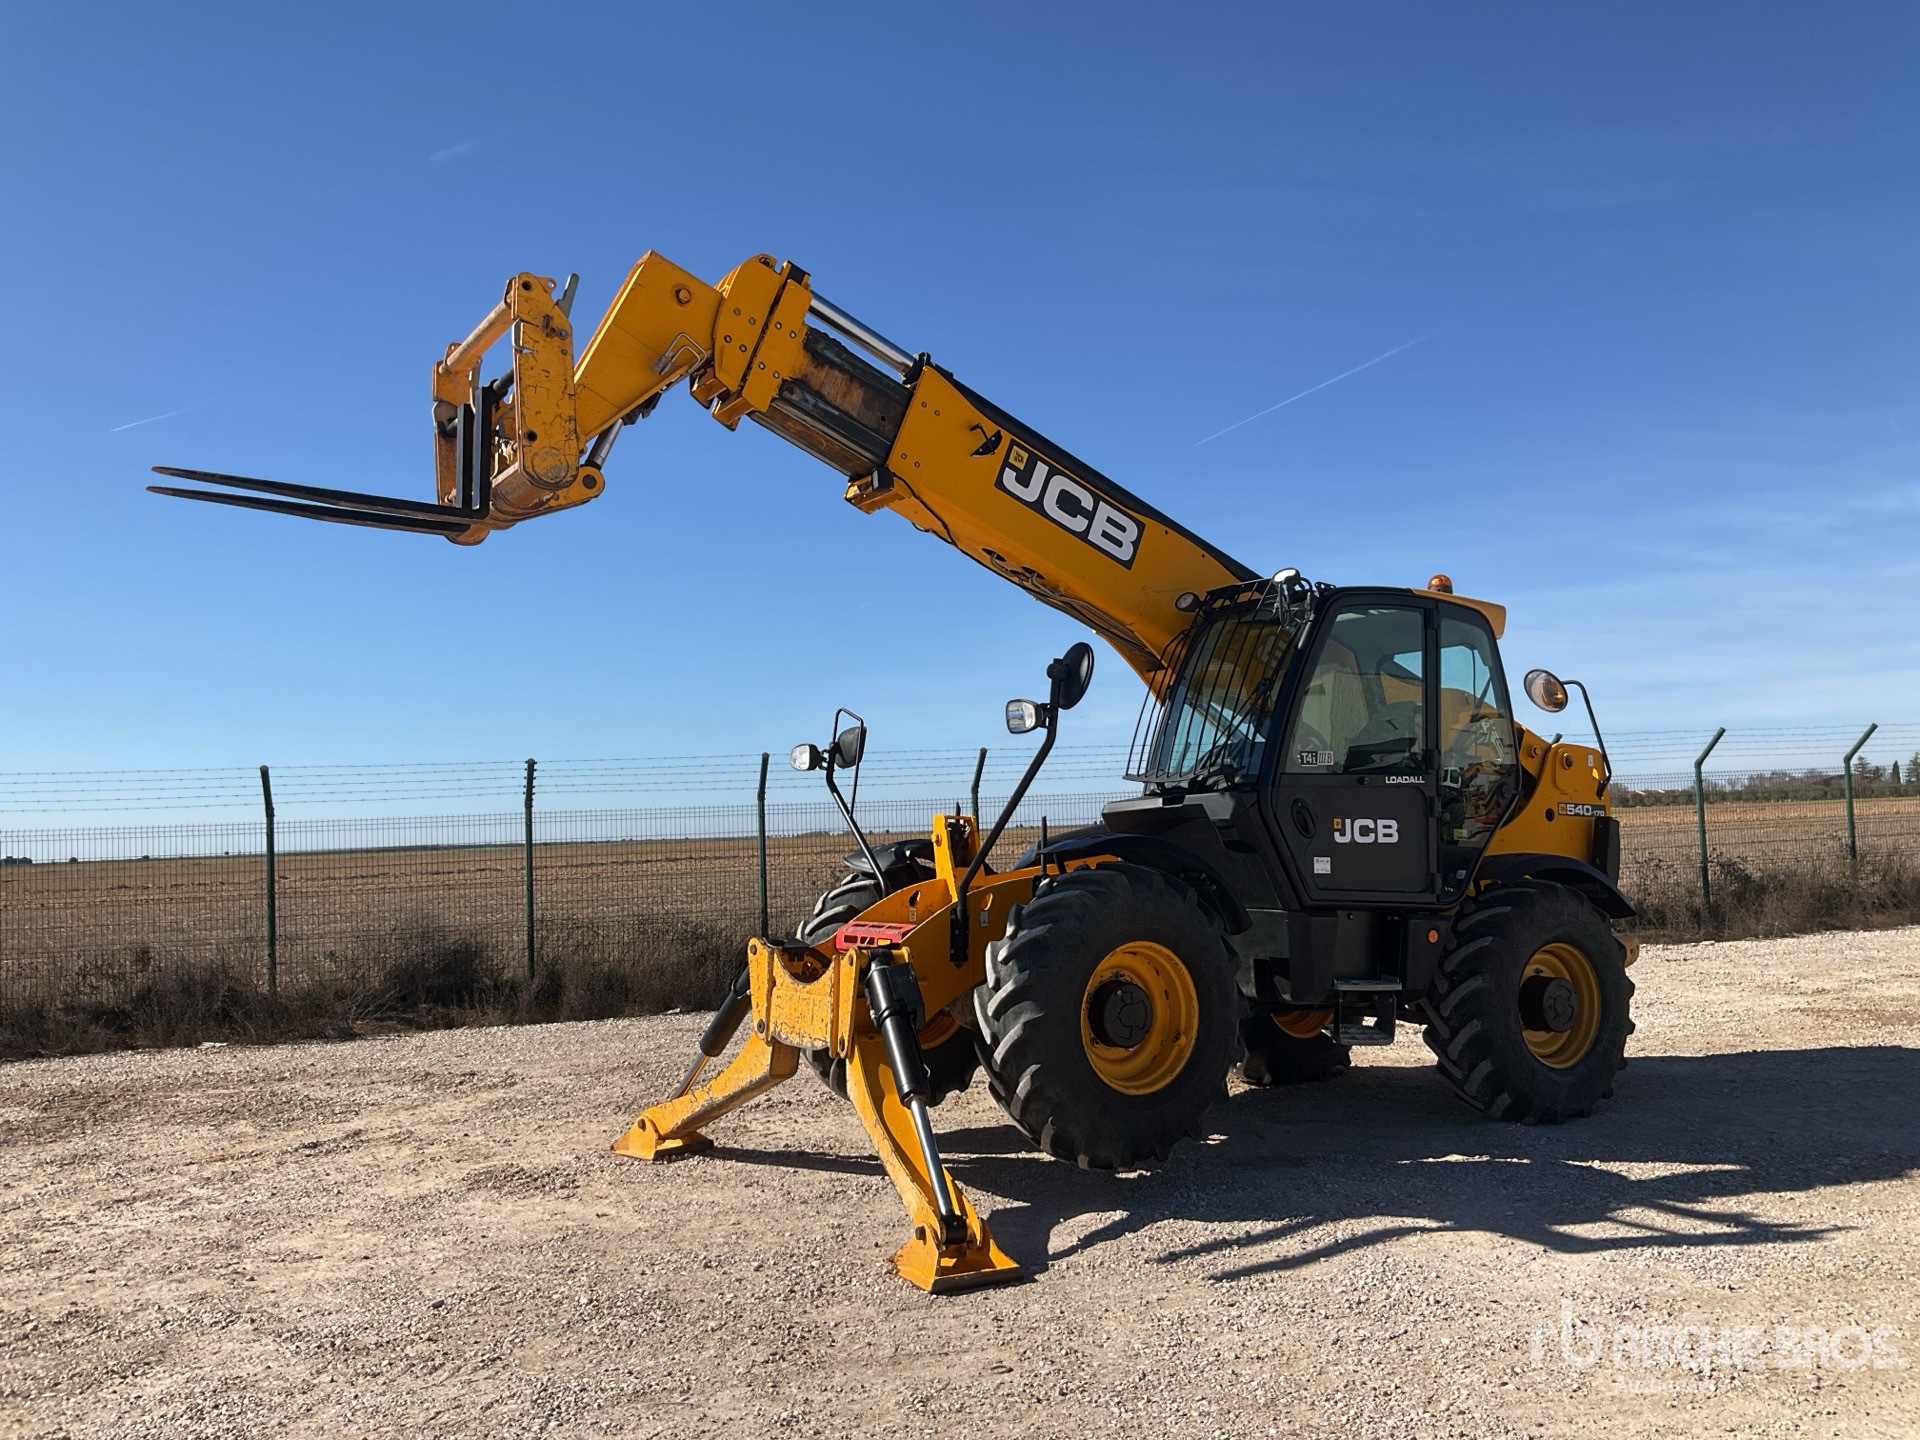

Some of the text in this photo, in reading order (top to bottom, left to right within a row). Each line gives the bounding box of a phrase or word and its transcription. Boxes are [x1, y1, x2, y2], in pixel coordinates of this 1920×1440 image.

[1002, 460, 1138, 561] JCB
[1385, 775, 1425, 784] LOADALL
[1333, 818, 1399, 843] JCB
